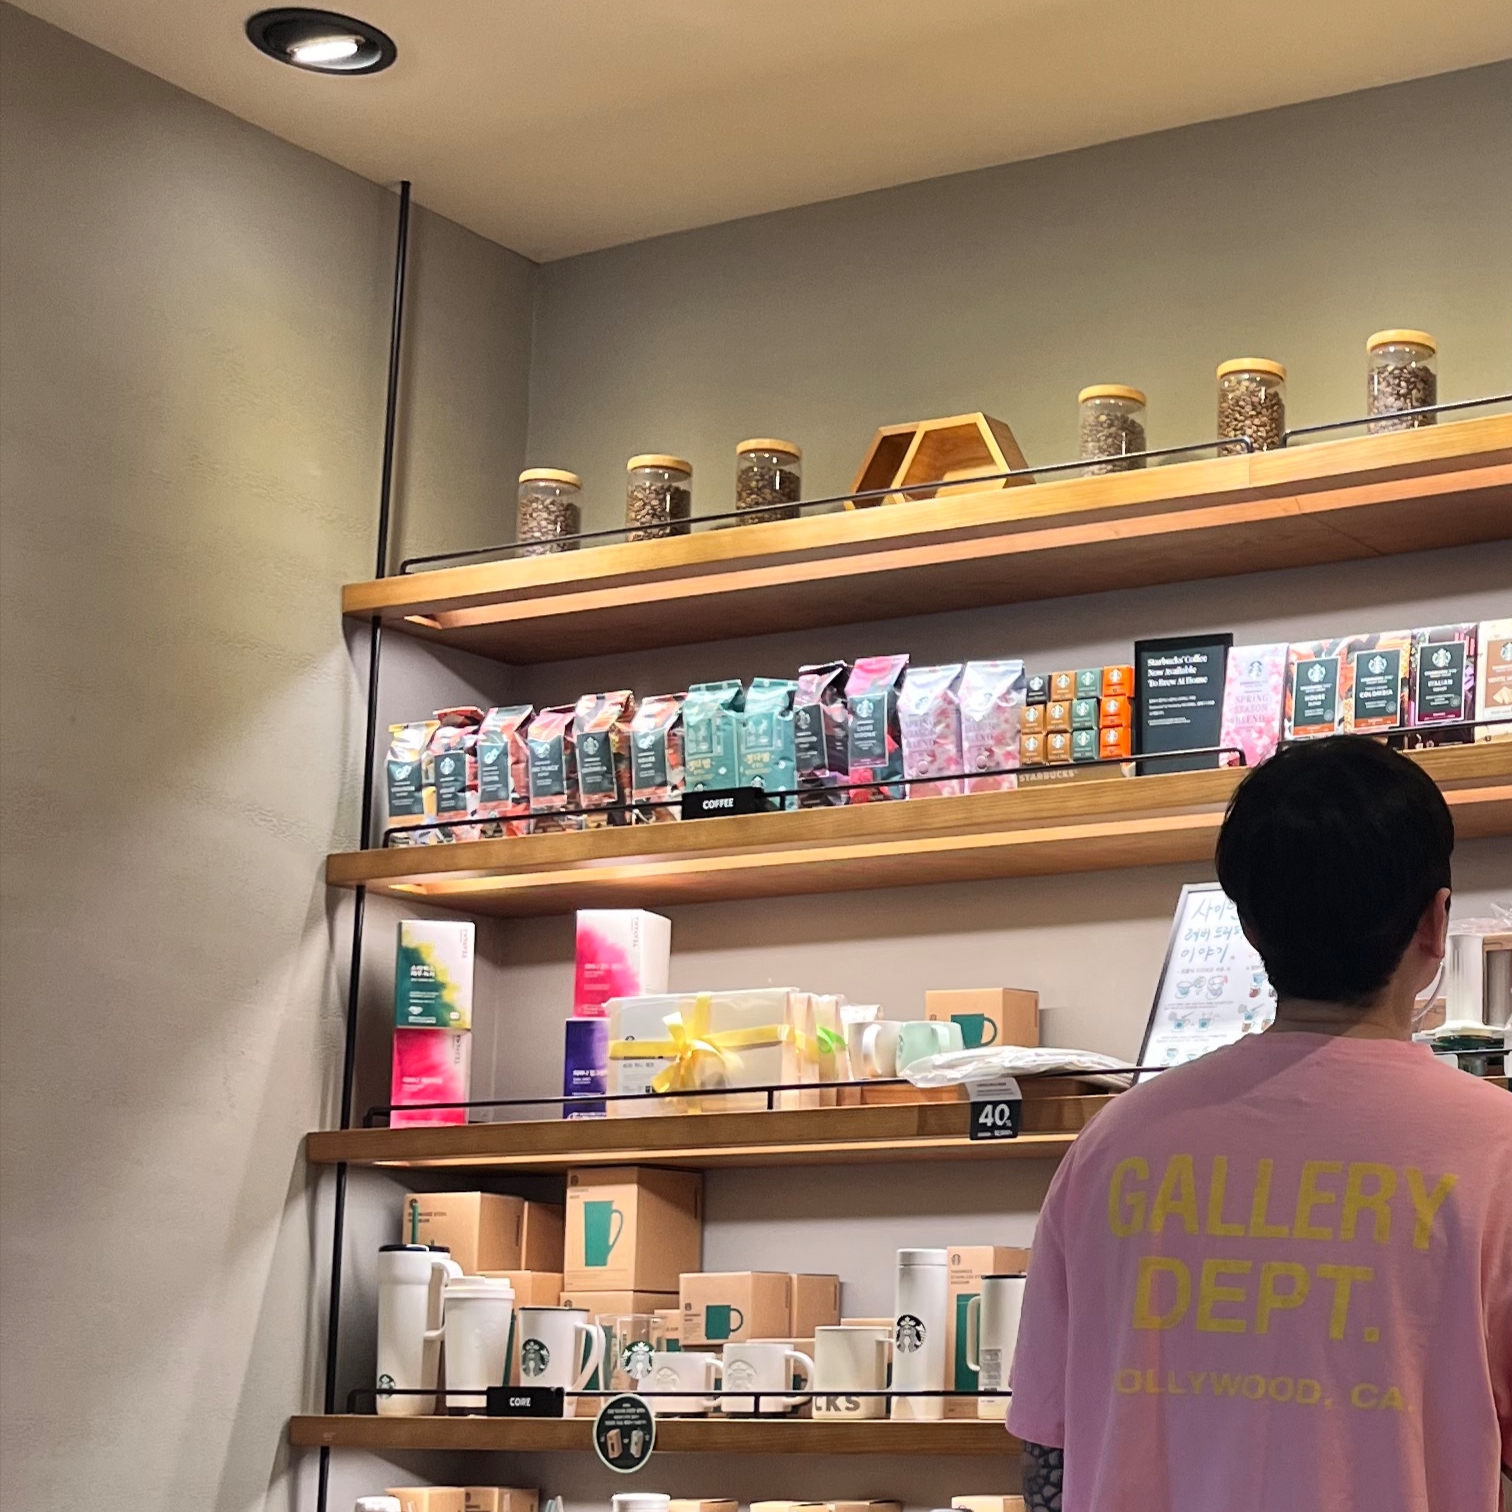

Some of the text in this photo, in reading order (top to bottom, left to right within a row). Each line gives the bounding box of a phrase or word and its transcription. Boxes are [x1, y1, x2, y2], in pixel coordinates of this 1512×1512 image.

[1235, 694, 1268, 704] SPRING
[1359, 689, 1393, 699] COLOMBIA
[1234, 704, 1267, 714] SEASON
[1235, 714, 1265, 723] BLEND
[1019, 770, 1074, 782] STARBUCKS
[702, 797, 734, 810] COFFEE
[1107, 1153, 1461, 1252] GALLERY
[1131, 1255, 1381, 1344] DEPT.
[1114, 1367, 1334, 1409] OLLYWOOD,
[509, 1397, 531, 1407] CORE
